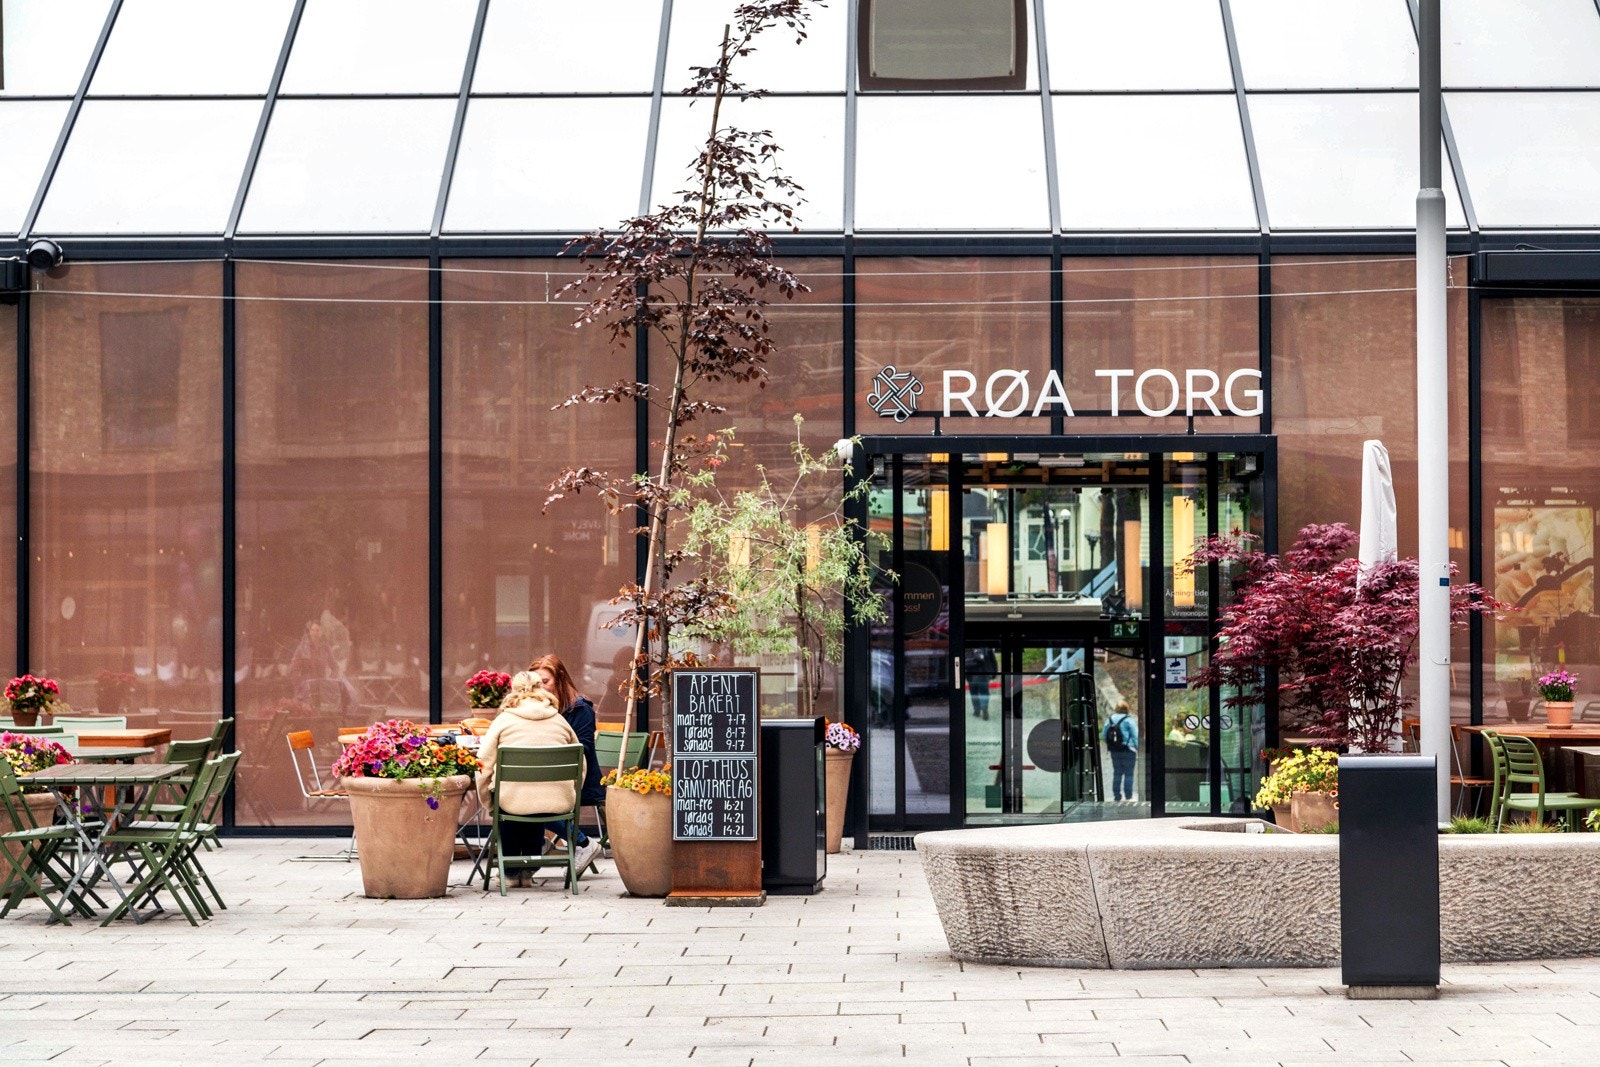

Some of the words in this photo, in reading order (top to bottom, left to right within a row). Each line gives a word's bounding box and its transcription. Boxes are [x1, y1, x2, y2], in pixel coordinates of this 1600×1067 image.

[942, 369, 1075, 418] RØA
[1094, 368, 1264, 418] TORG
[903, 592, 935, 600] mmen
[689, 695, 741, 714] BAKERI
[677, 713, 713, 726] man-fre
[726, 714, 746, 726] 7-17
[684, 726, 714, 740] lørdag
[725, 726, 746, 739] 8-17
[683, 739, 714, 752] søndag
[725, 739, 745, 751] 9-17
[683, 759, 749, 780] LOFTHUS
[677, 779, 753, 799] SAMVIRKELAG
[677, 798, 713, 811] man-fre
[723, 800, 744, 811] 16-21
[684, 811, 714, 825] lørdag
[723, 813, 745, 824] 14-21
[683, 824, 714, 837] søndag
[723, 825, 745, 836] 14-21
